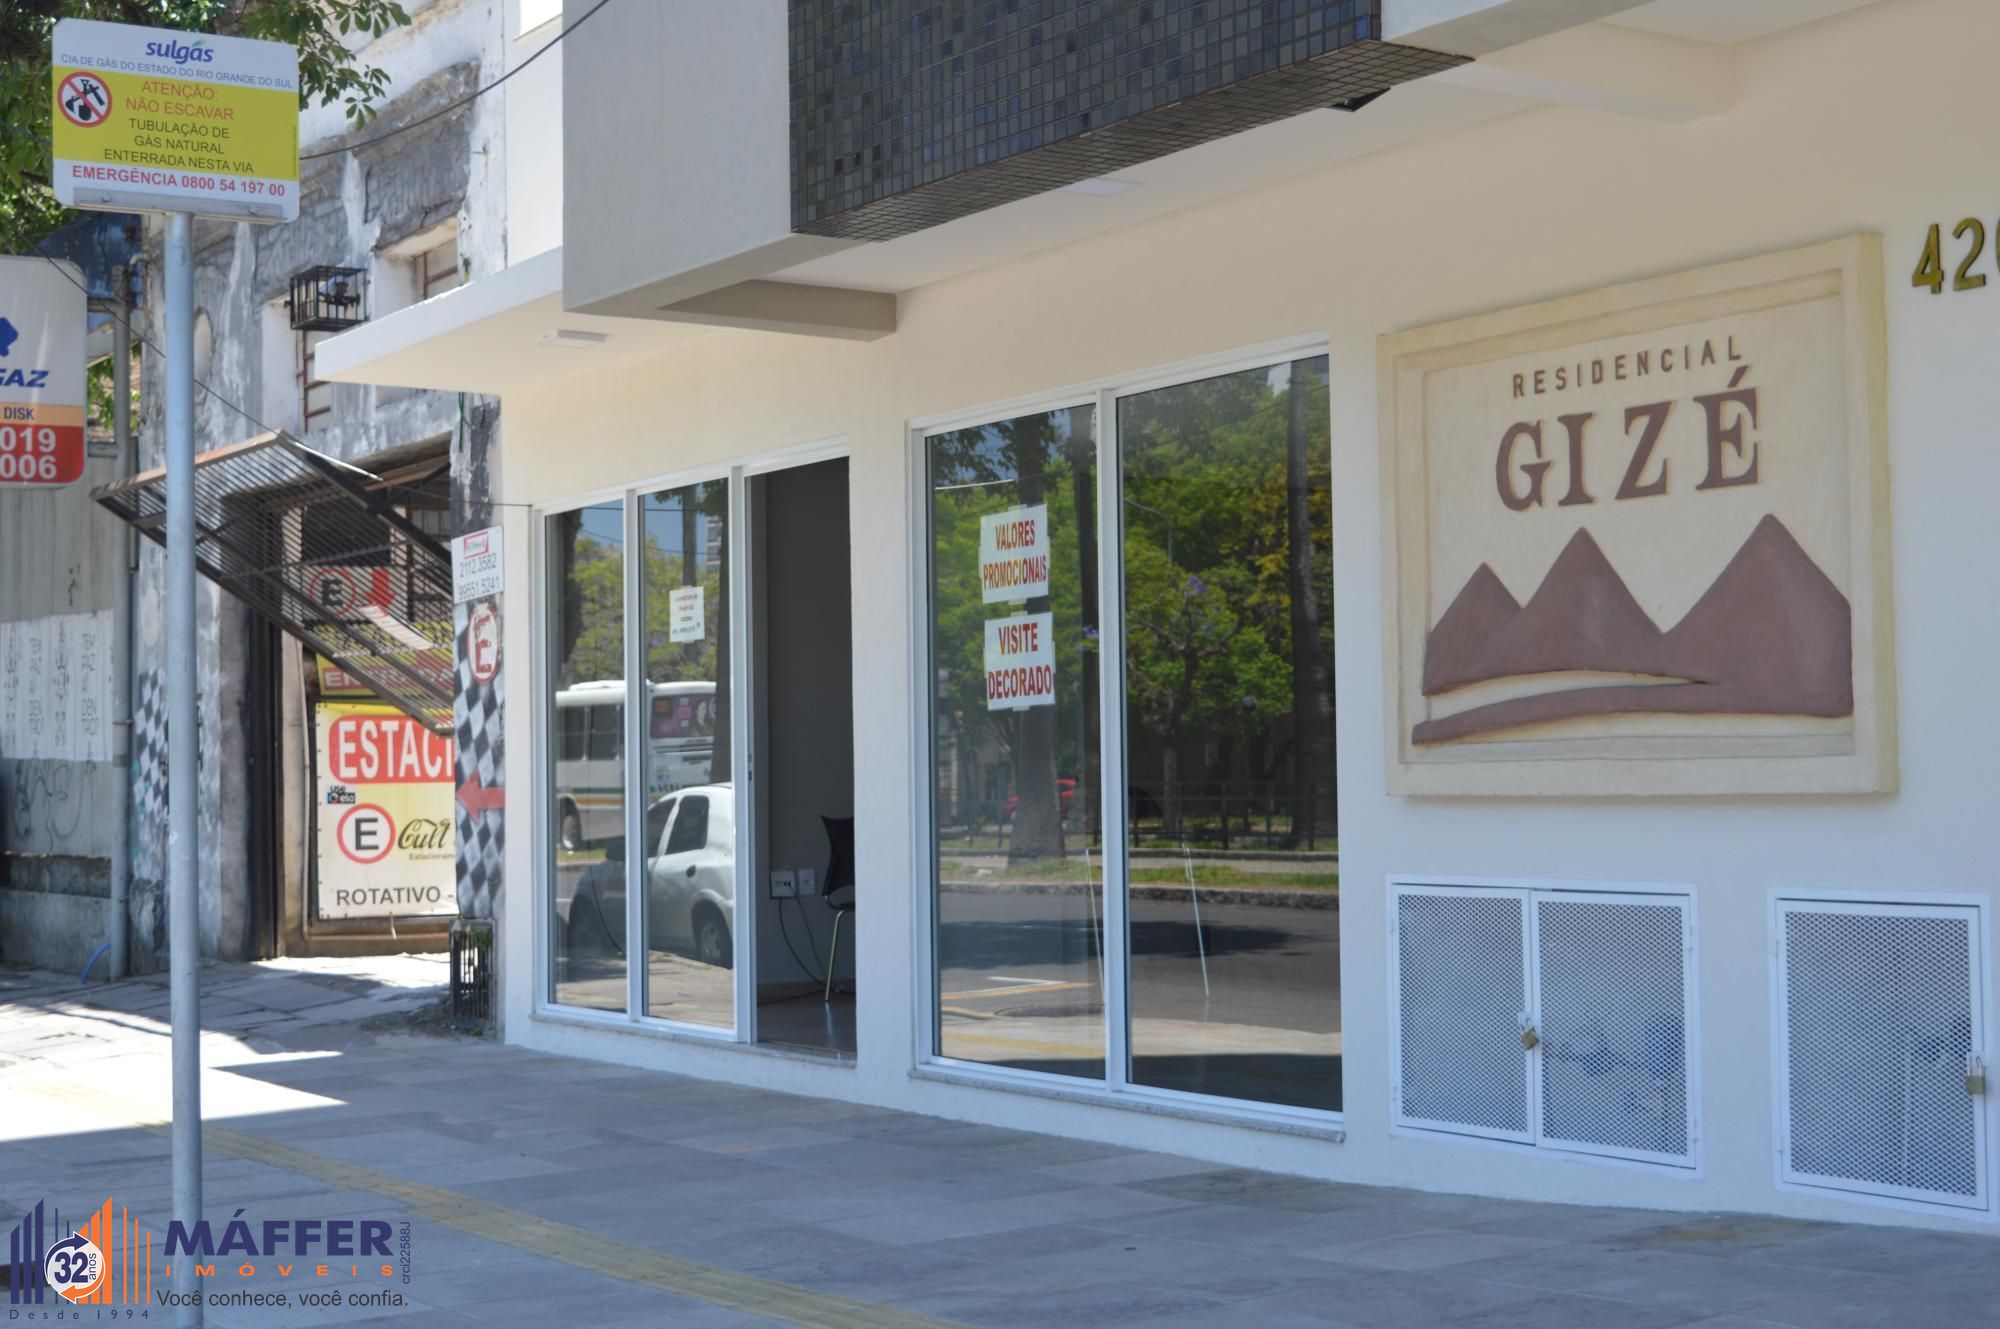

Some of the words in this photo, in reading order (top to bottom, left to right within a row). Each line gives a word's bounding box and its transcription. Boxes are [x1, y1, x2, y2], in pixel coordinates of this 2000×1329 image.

[145, 39, 214, 65] sulgás
[61, 54, 78, 64] CIA
[80, 56, 94, 66] DE
[96, 58, 118, 69] GÁS
[120, 61, 135, 71] DO
[138, 63, 177, 76] ESTADO
[179, 67, 194, 77] DO
[196, 69, 213, 80] RIO
[215, 72, 256, 84] GRANDE
[258, 77, 272, 86] DO
[274, 78, 293, 88] SUL
[126, 97, 160, 113] NÃO
[164, 100, 234, 120] ESCAVAR
[129, 118, 208, 137] TUBULAÇÃO
[212, 126, 230, 138] DE
[134, 134, 162, 148] GÁS
[166, 138, 225, 154] NATURAL
[104, 148, 186, 167] ENTERRADA
[188, 157, 230, 171] NESTA
[232, 161, 254, 173] VIA
[72, 165, 177, 186] EMERGÊNCIA
[181, 175, 215, 190] 0800
[219, 179, 235, 192] 54
[240, 181, 264, 194] 197
[269, 184, 285, 197] 00
[1912, 216, 2000, 294] 42
[1512, 336, 1742, 398] RESIDENCIAL
[3, 407, 34, 420] DISK
[1496, 365, 1760, 512] GIZÉ
[995, 519, 1036, 550] VALORES
[983, 555, 1047, 590] PROMOCIONAIS
[998, 622, 1038, 655] VISITE
[987, 664, 1052, 701] DECORADO
[355, 817, 379, 851] E
[336, 886, 441, 906] ROTATIVO
